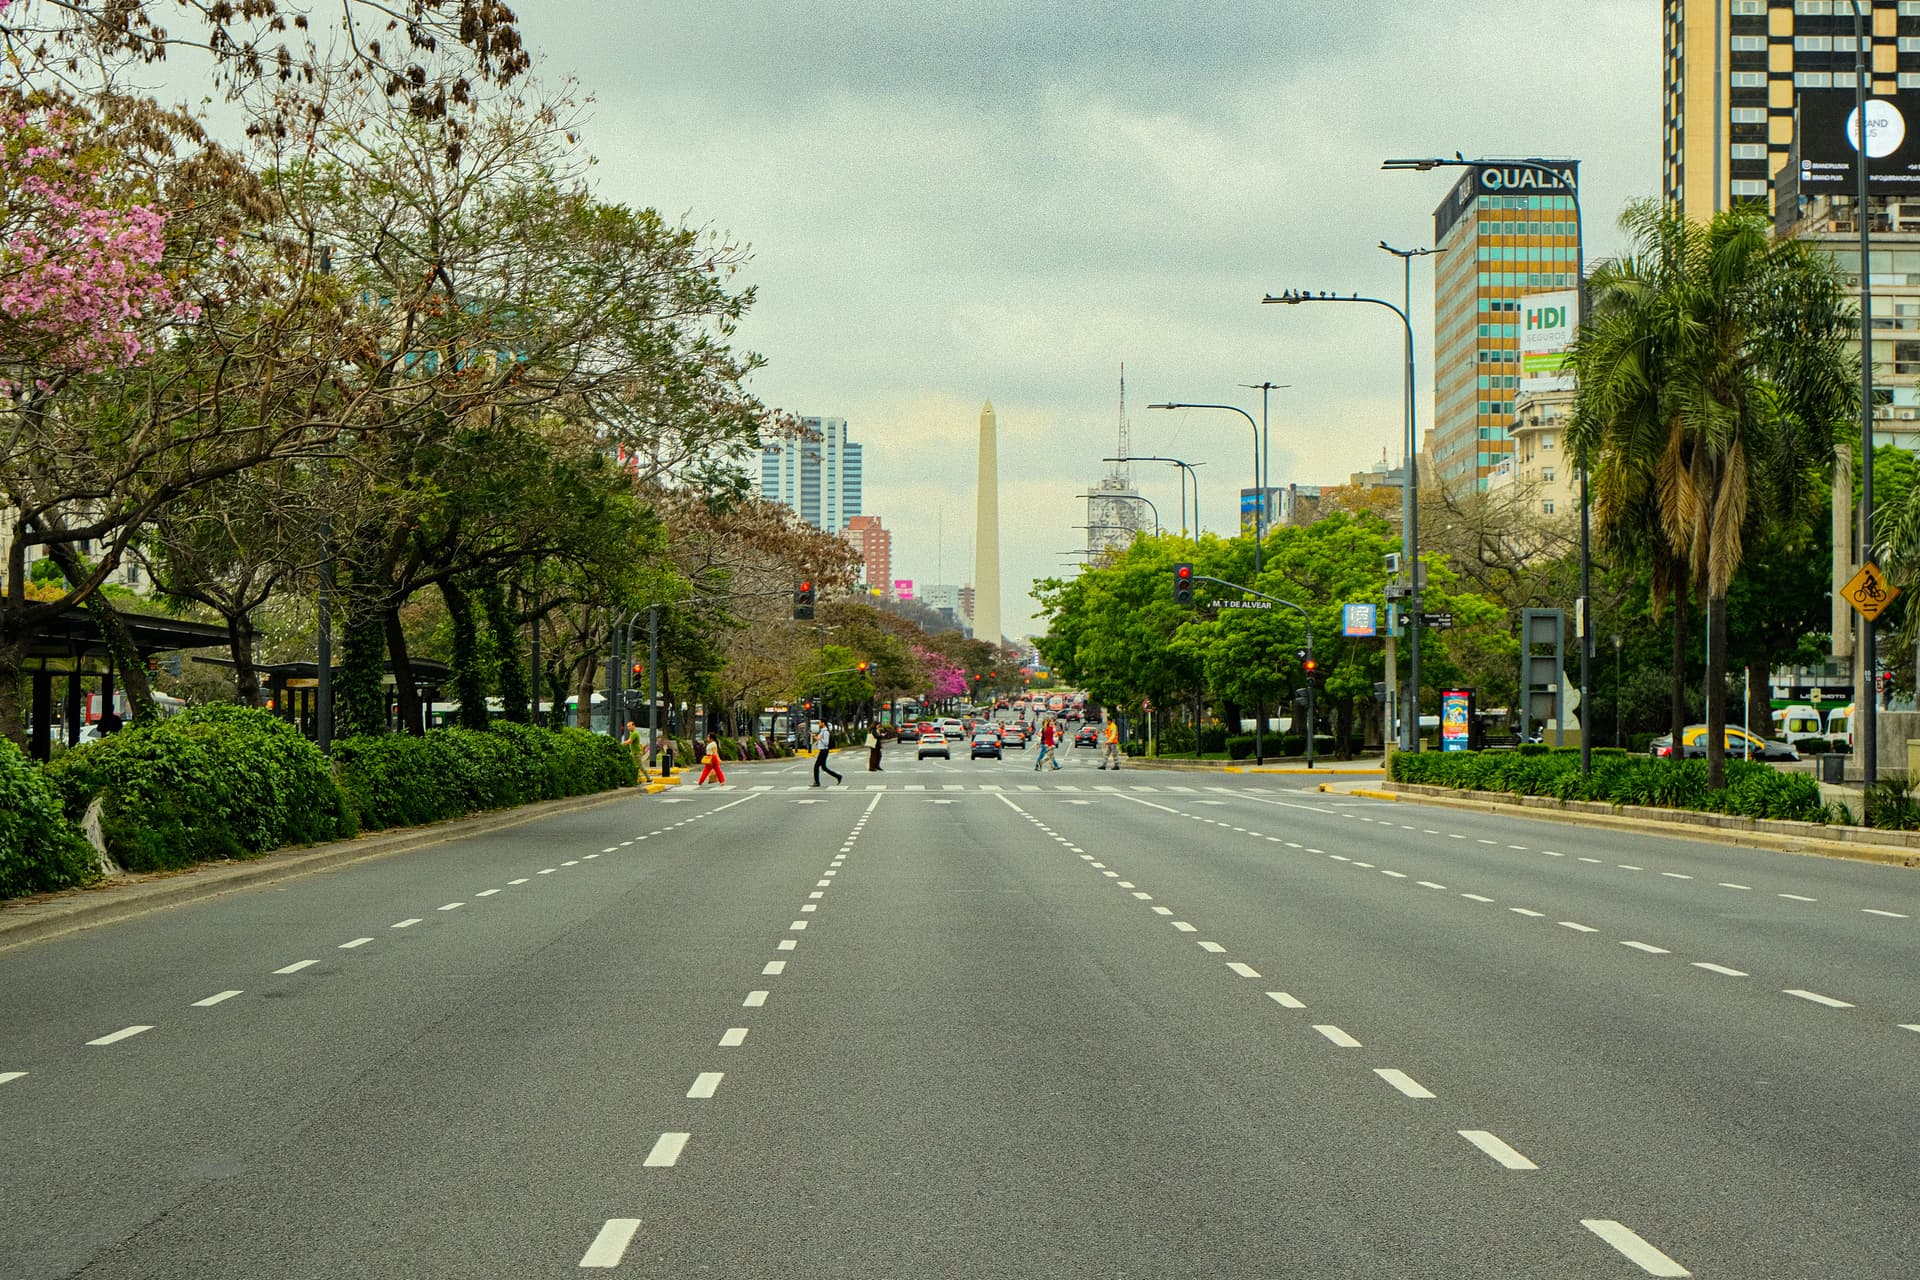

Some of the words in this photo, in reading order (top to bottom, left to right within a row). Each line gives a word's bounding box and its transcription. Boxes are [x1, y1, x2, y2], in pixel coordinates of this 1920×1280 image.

[1481, 168, 1576, 190] QUALIA
[1527, 306, 1566, 330] HDI
[1526, 331, 1566, 342] SEGUROS
[1230, 600, 1240, 608] DE
[1241, 601, 1271, 609] ALVEAR
